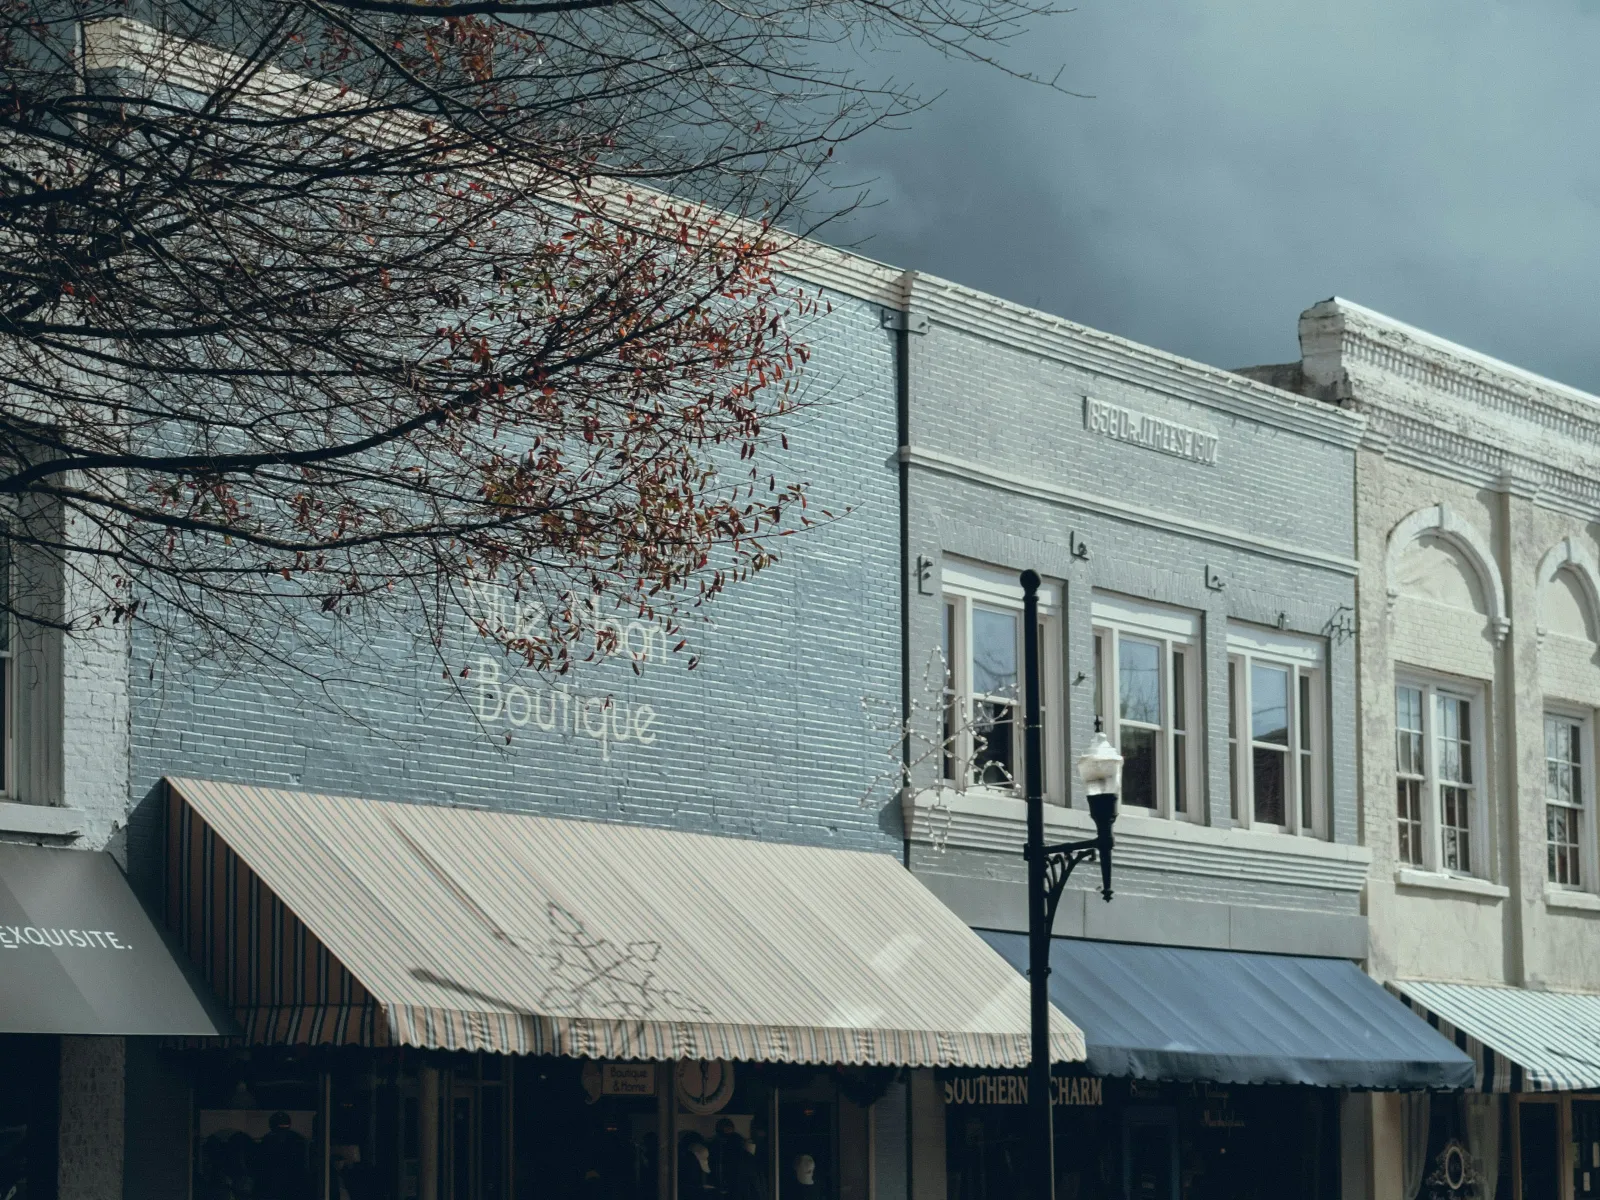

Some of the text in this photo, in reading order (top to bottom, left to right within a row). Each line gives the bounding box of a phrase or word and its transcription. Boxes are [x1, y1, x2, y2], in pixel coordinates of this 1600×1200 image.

[478, 656, 657, 762] Boutique
[944, 1075, 1029, 1105] SOUTHERN
[1049, 1076, 1103, 1105] CHARM
